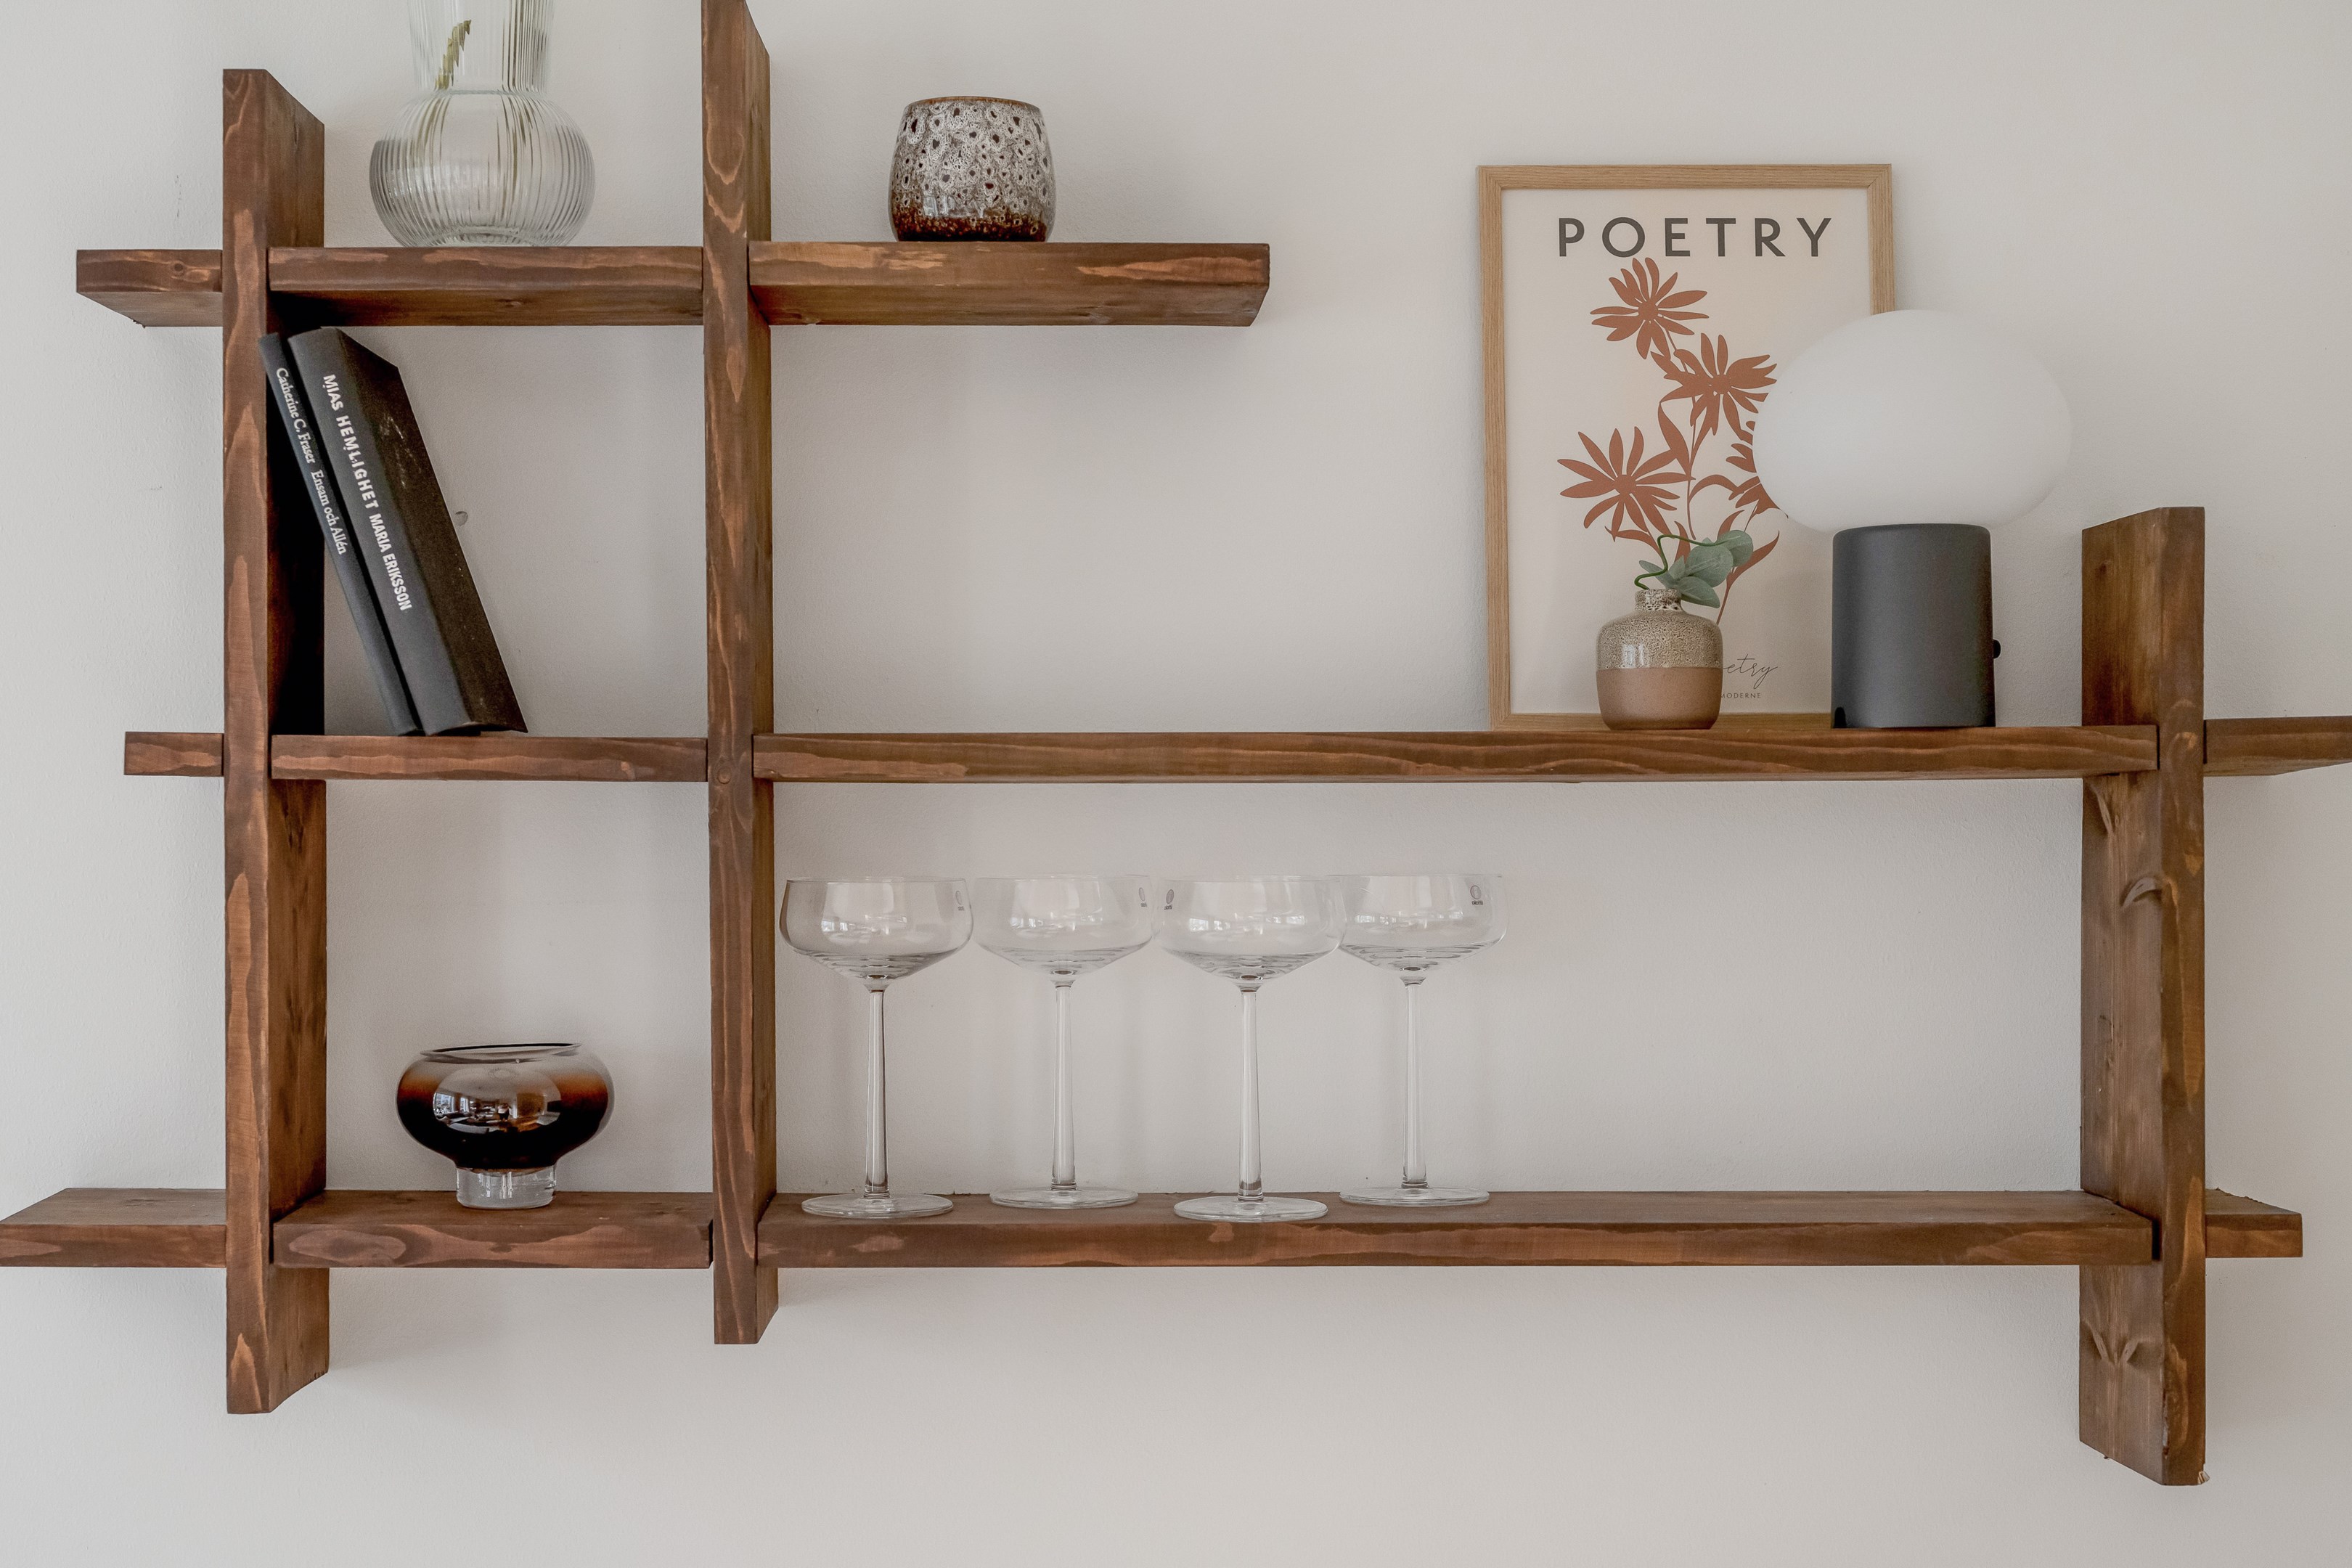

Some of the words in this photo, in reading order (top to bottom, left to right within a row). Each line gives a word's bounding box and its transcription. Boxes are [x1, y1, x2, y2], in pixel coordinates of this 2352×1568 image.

[1559, 217, 1832, 258] POETRY
[277, 368, 299, 418] Catherine
[293, 419, 306, 433] C.
[298, 432, 316, 464] Fraser
[311, 469, 330, 507] Ensam
[324, 507, 340, 526] och
[330, 527, 348, 555] Allén
[369, 513, 392, 552] MARIA
[382, 553, 412, 611] ERIKSSON
[1723, 653, 1779, 690] etry
